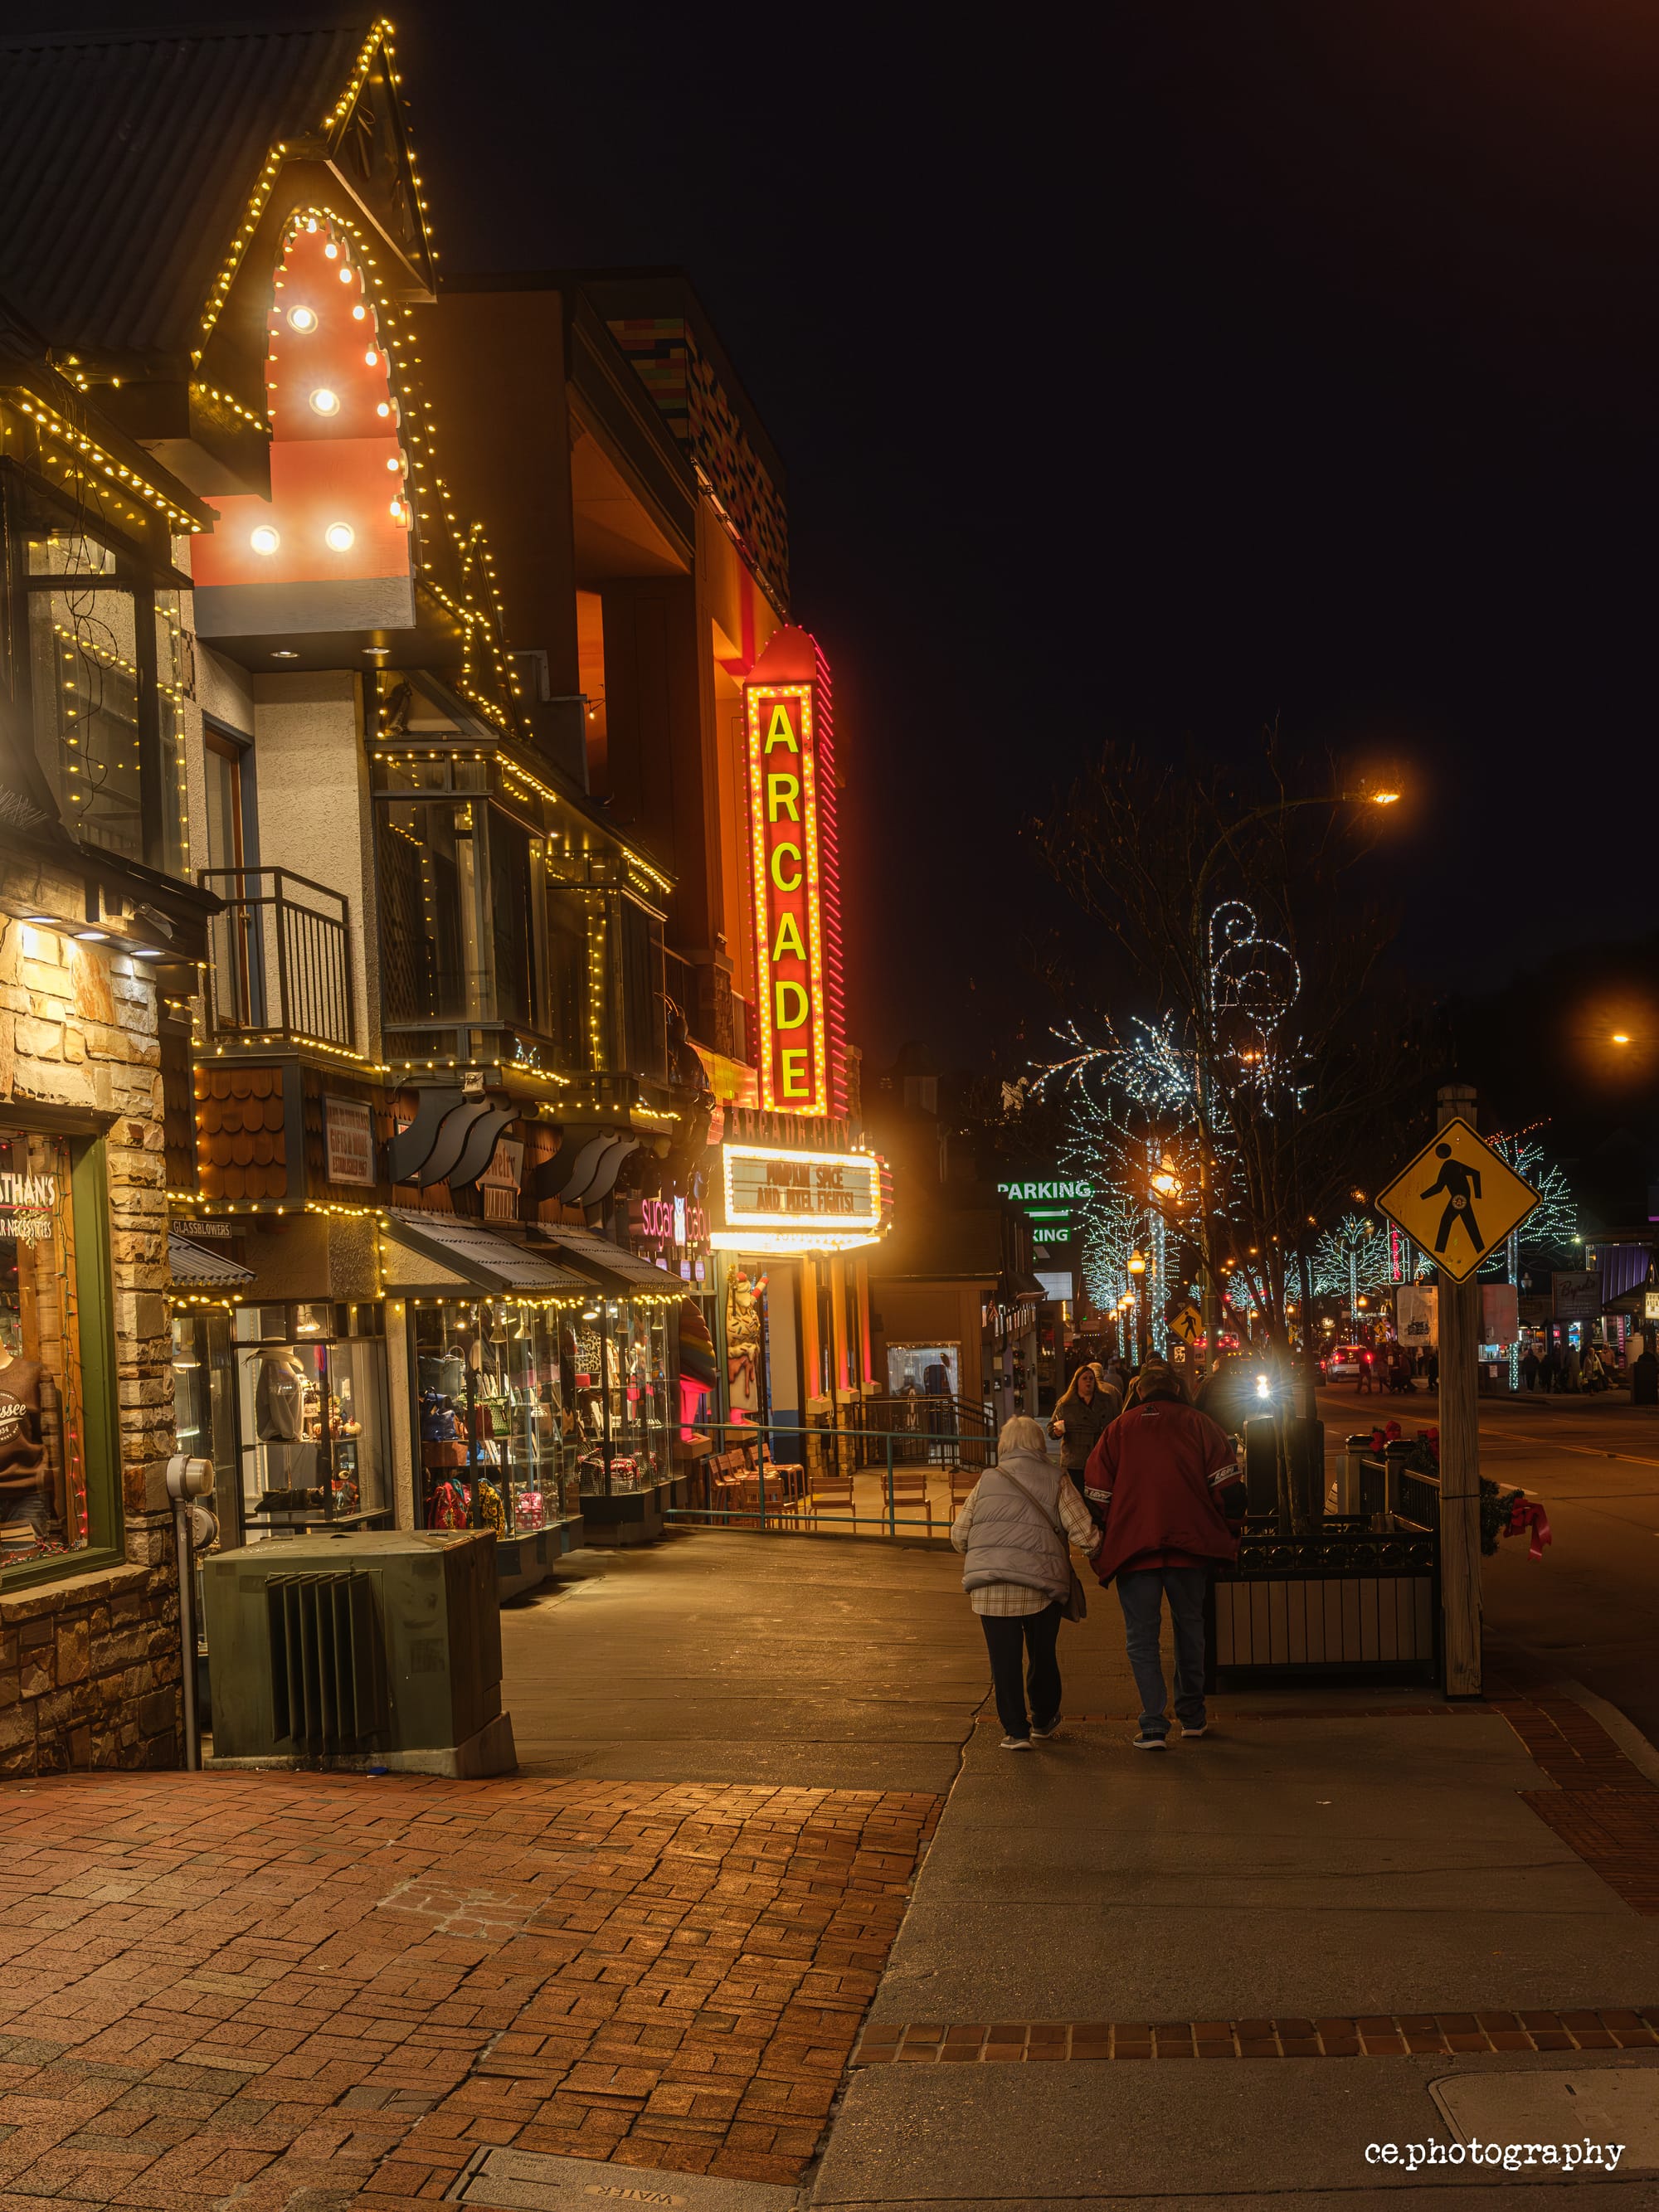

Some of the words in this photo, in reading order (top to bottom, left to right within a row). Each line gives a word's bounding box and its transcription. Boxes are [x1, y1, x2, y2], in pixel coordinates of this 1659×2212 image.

[764, 704, 810, 1098] ARCADE
[732, 1106, 806, 1146] ARCADE
[812, 1118, 850, 1150] CITY
[487, 1146, 516, 1185] welry
[766, 1163, 810, 1188] PUMPKIN
[816, 1167, 844, 1189] SPICE
[757, 1188, 781, 1211] AND
[786, 1189, 814, 1212] PIXEL
[173, 1221, 230, 1236] GLASSBLOWERS
[642, 1198, 674, 1252] sugar
[685, 1195, 711, 1256] baby
[0, 1403, 27, 1419] ssee
[596, 2185, 674, 2205] WATER
